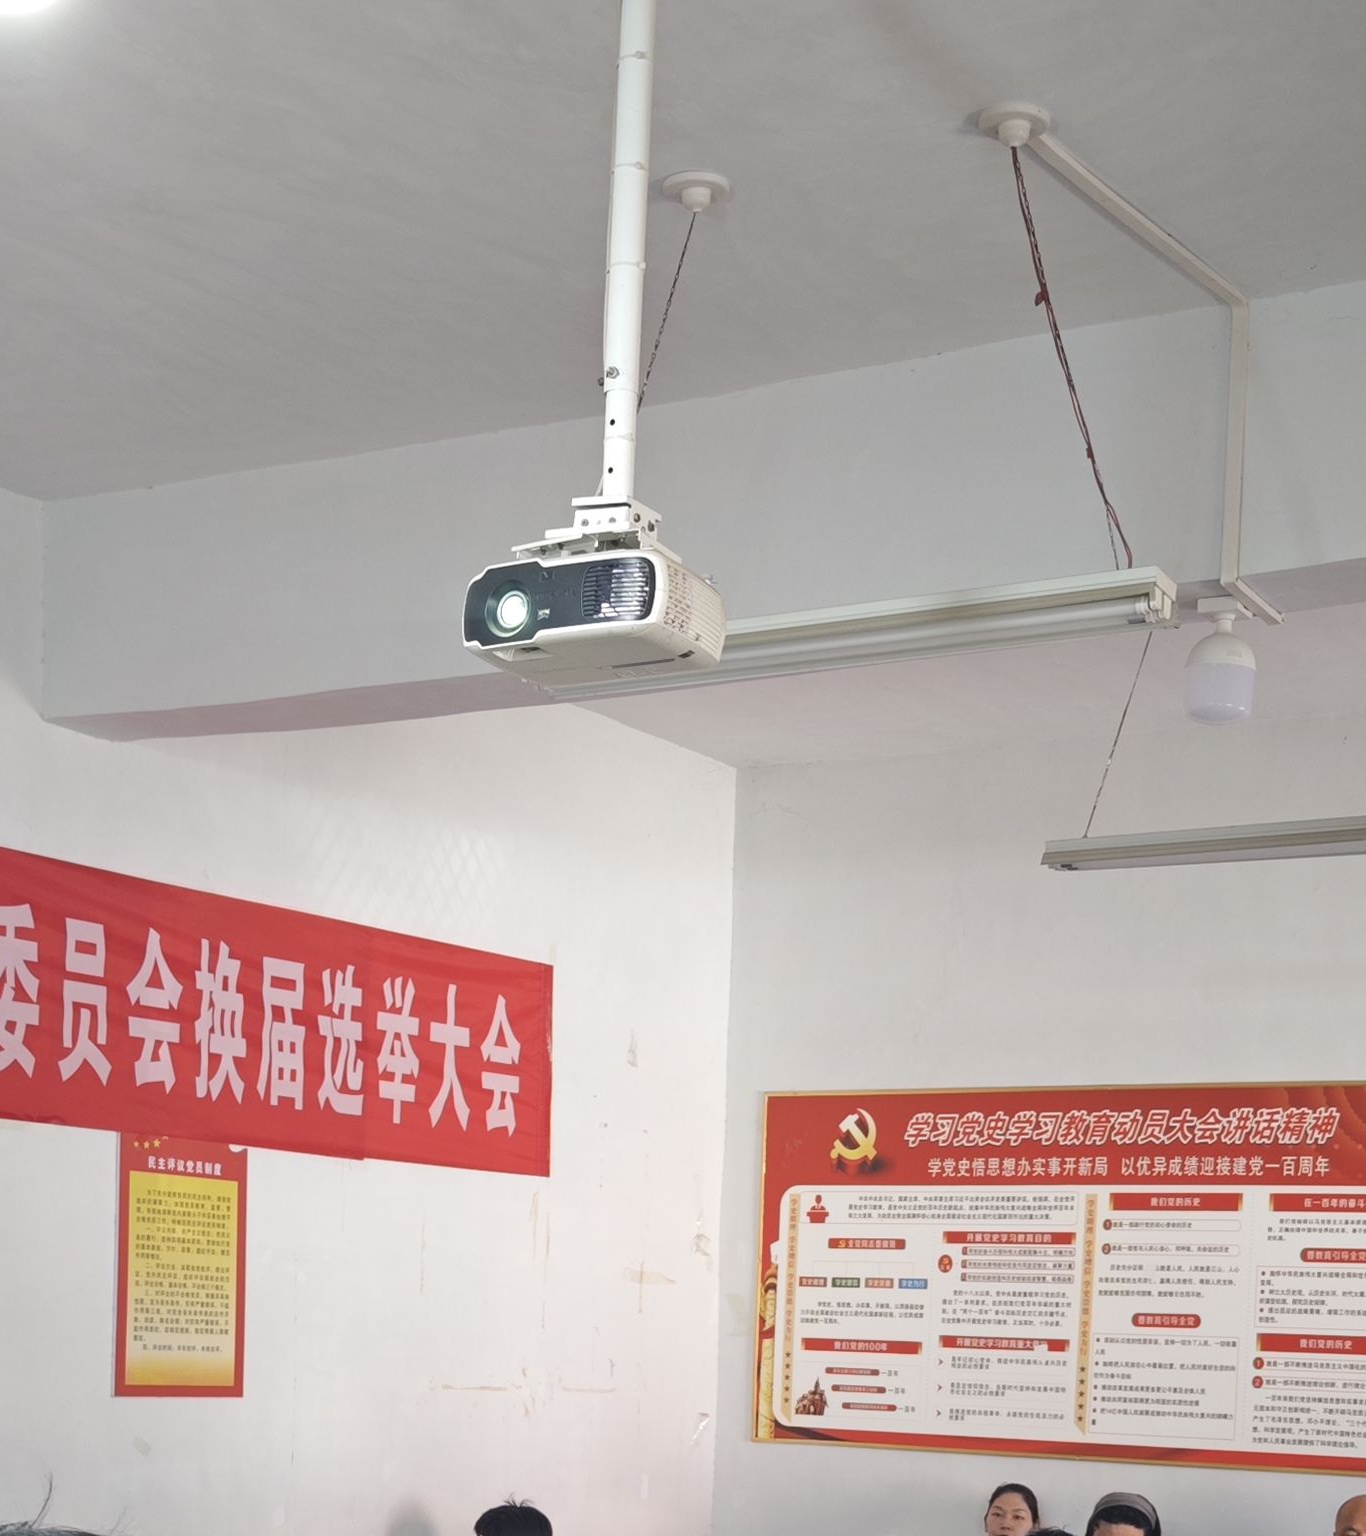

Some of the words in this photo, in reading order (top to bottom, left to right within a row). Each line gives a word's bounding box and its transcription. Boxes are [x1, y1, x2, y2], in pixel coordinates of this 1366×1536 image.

[903, 1108, 1340, 1148] 学习党史学习教育动员大会讲话精神
[148, 1156, 222, 1176] 民主评议党员制度
[928, 1156, 1108, 1178] 学党史悟思想办实事开新局
[1121, 1155, 1330, 1177] 以优异成绩迎接建党一百周年
[1300, 1339, 1353, 1350] 我们党的历史
